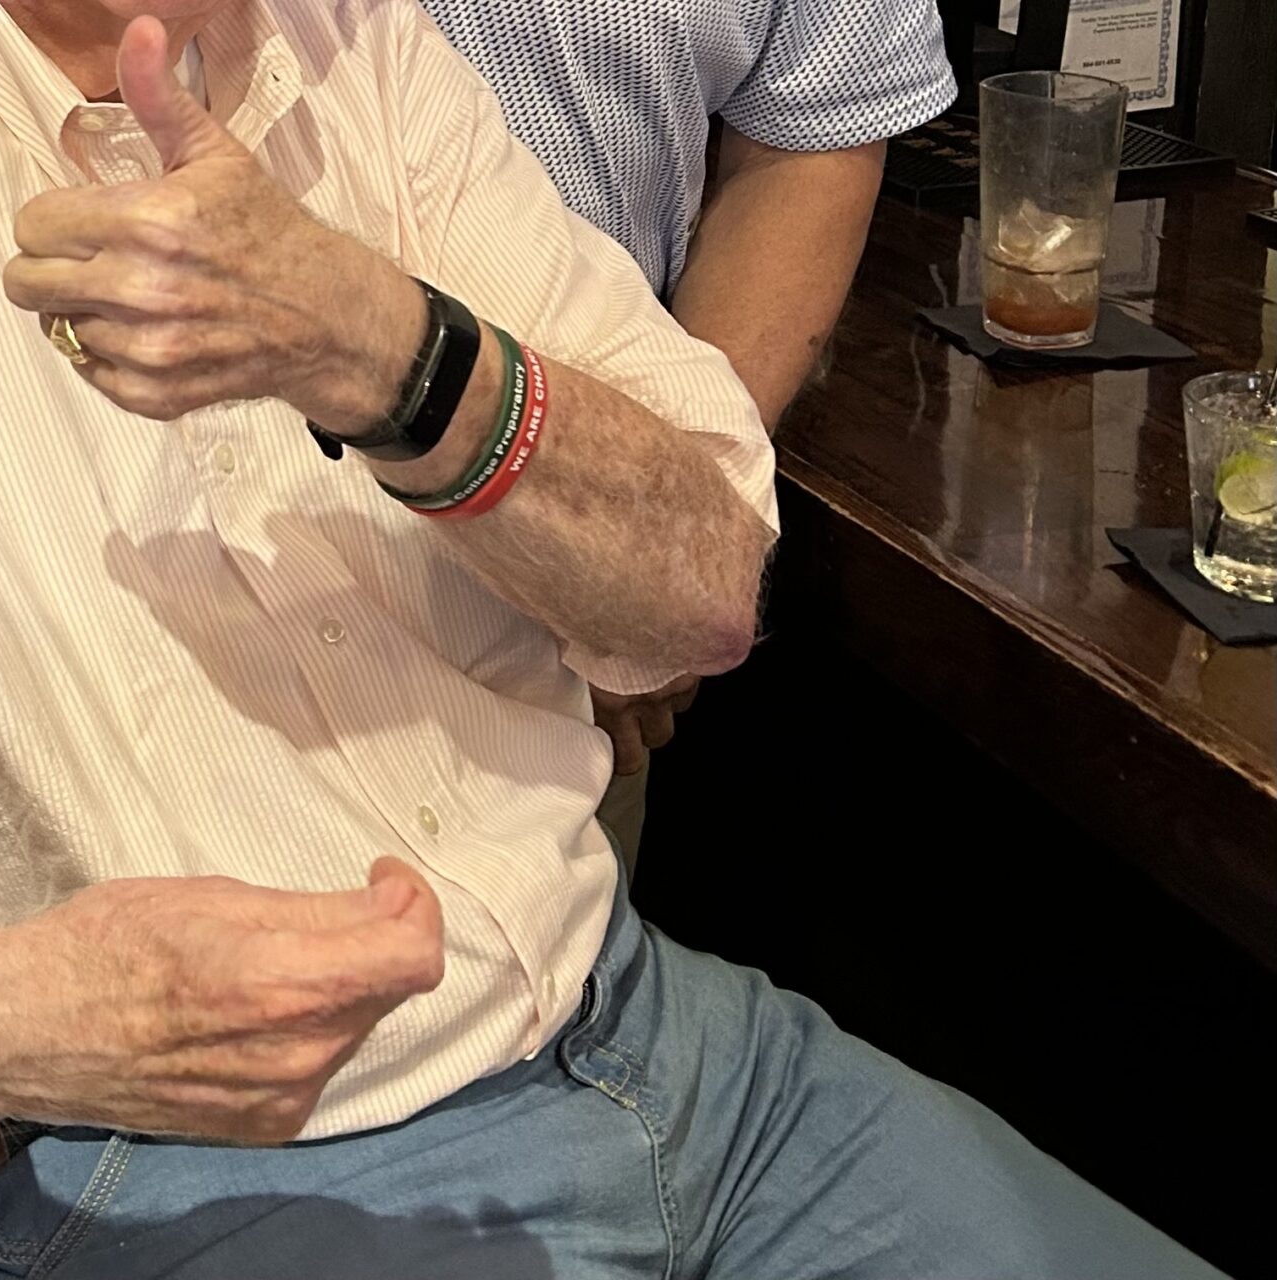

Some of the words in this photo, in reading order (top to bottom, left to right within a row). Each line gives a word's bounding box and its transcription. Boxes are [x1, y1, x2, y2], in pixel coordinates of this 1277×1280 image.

[453, 457, 499, 500] College
[494, 362, 526, 455] Preparatory
[510, 446, 530, 472] WE
[526, 406, 543, 442] ARE
